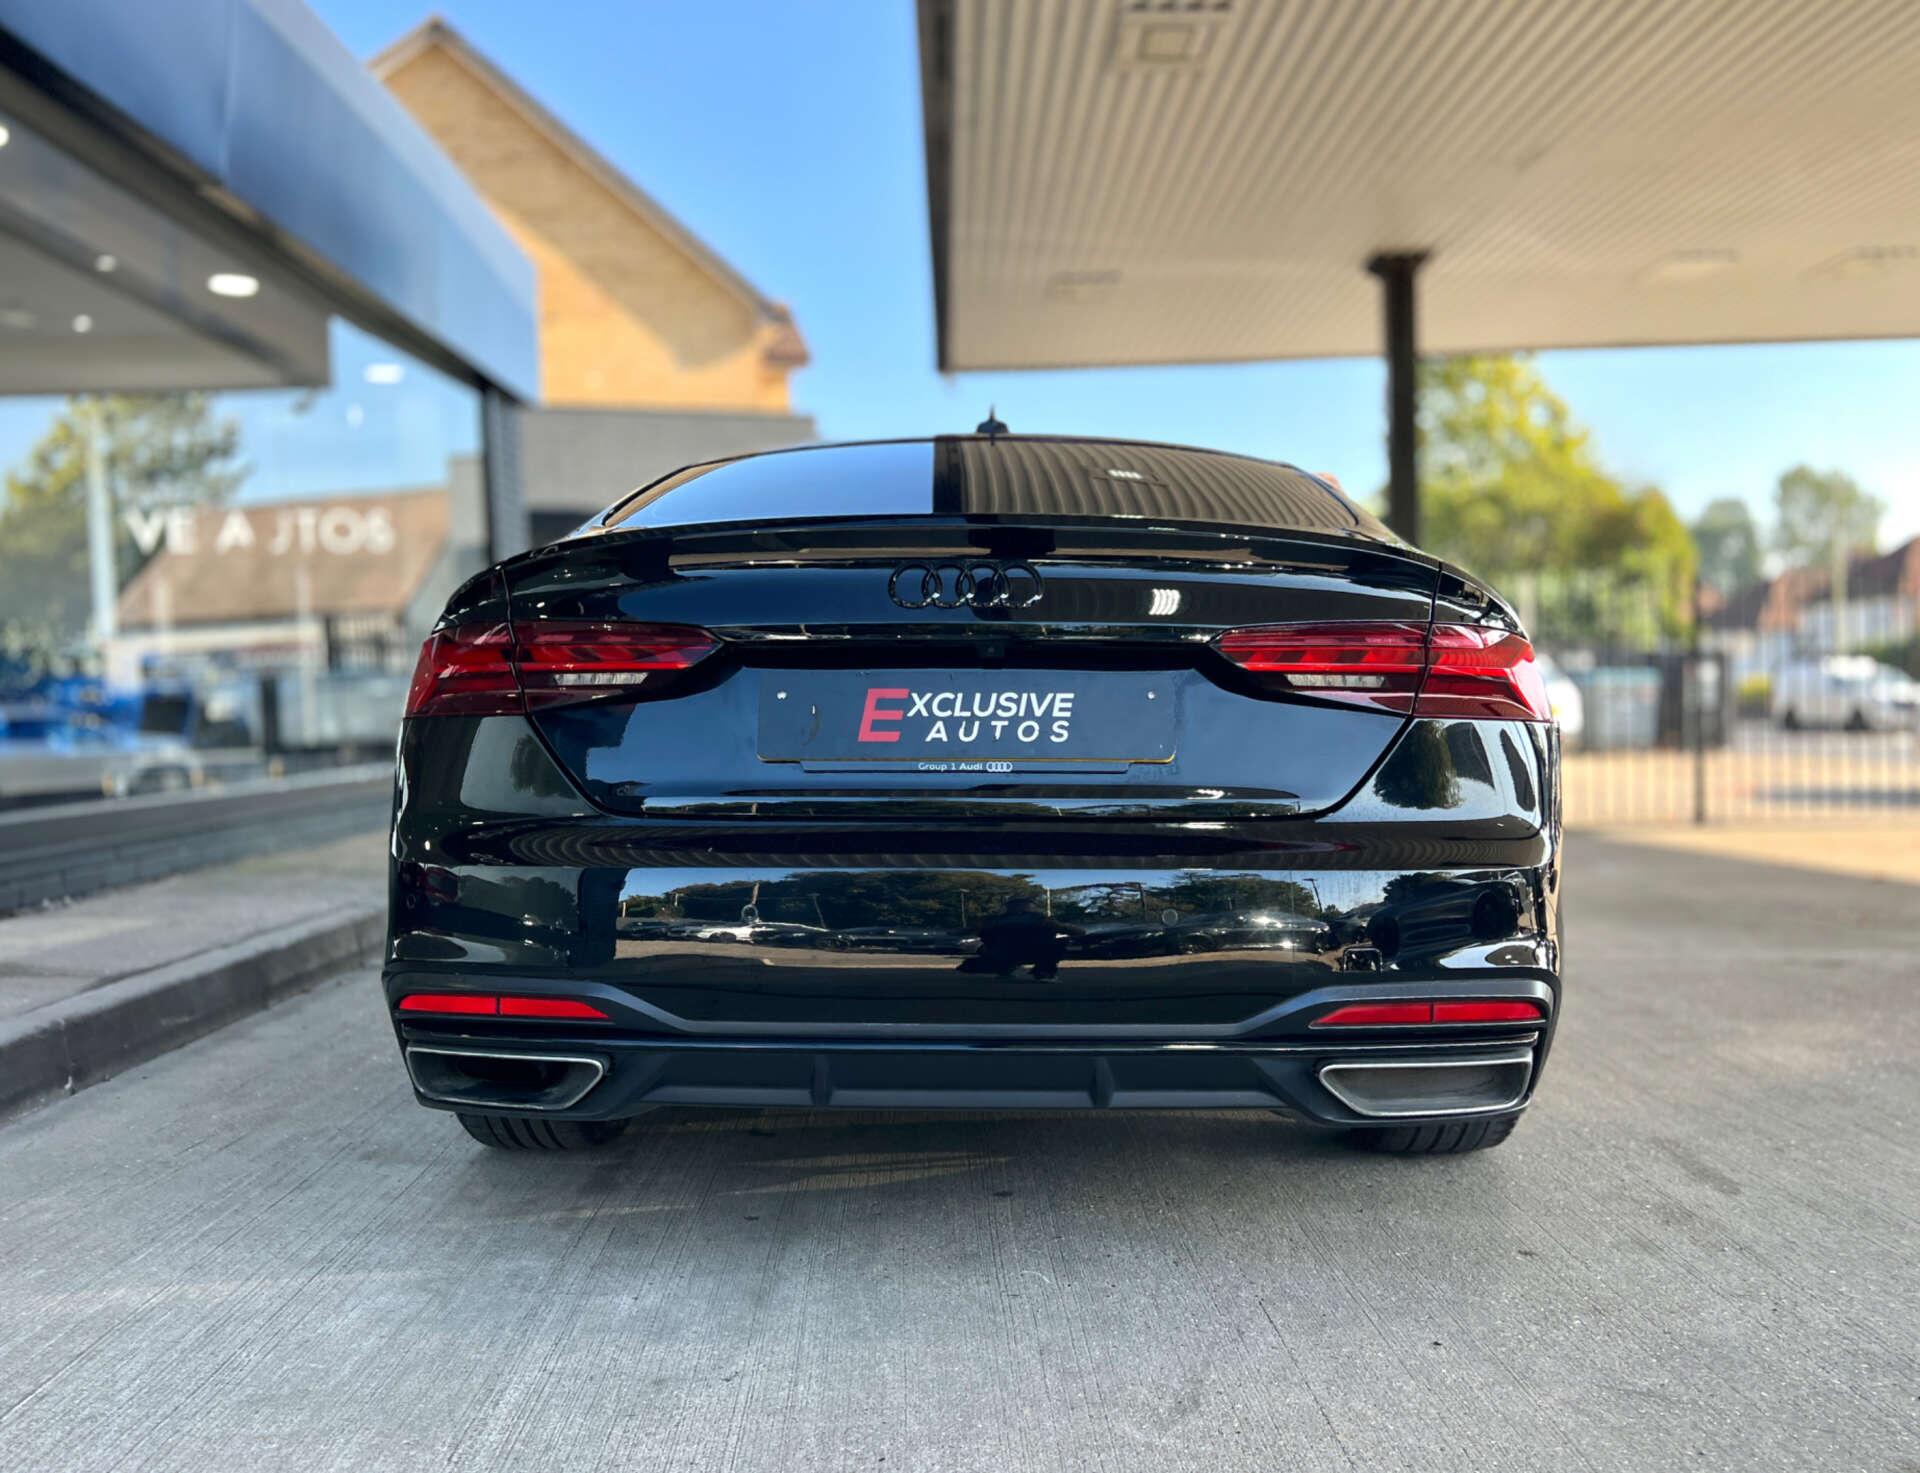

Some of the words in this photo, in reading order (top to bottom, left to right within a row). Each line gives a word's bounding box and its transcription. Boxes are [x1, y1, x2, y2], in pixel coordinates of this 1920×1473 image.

[857, 687, 1075, 743] EXCLUSIVE
[925, 720, 1070, 743] AUTOS
[918, 762, 948, 772] Group
[951, 762, 957, 771] 1
[959, 762, 984, 771] Audi
